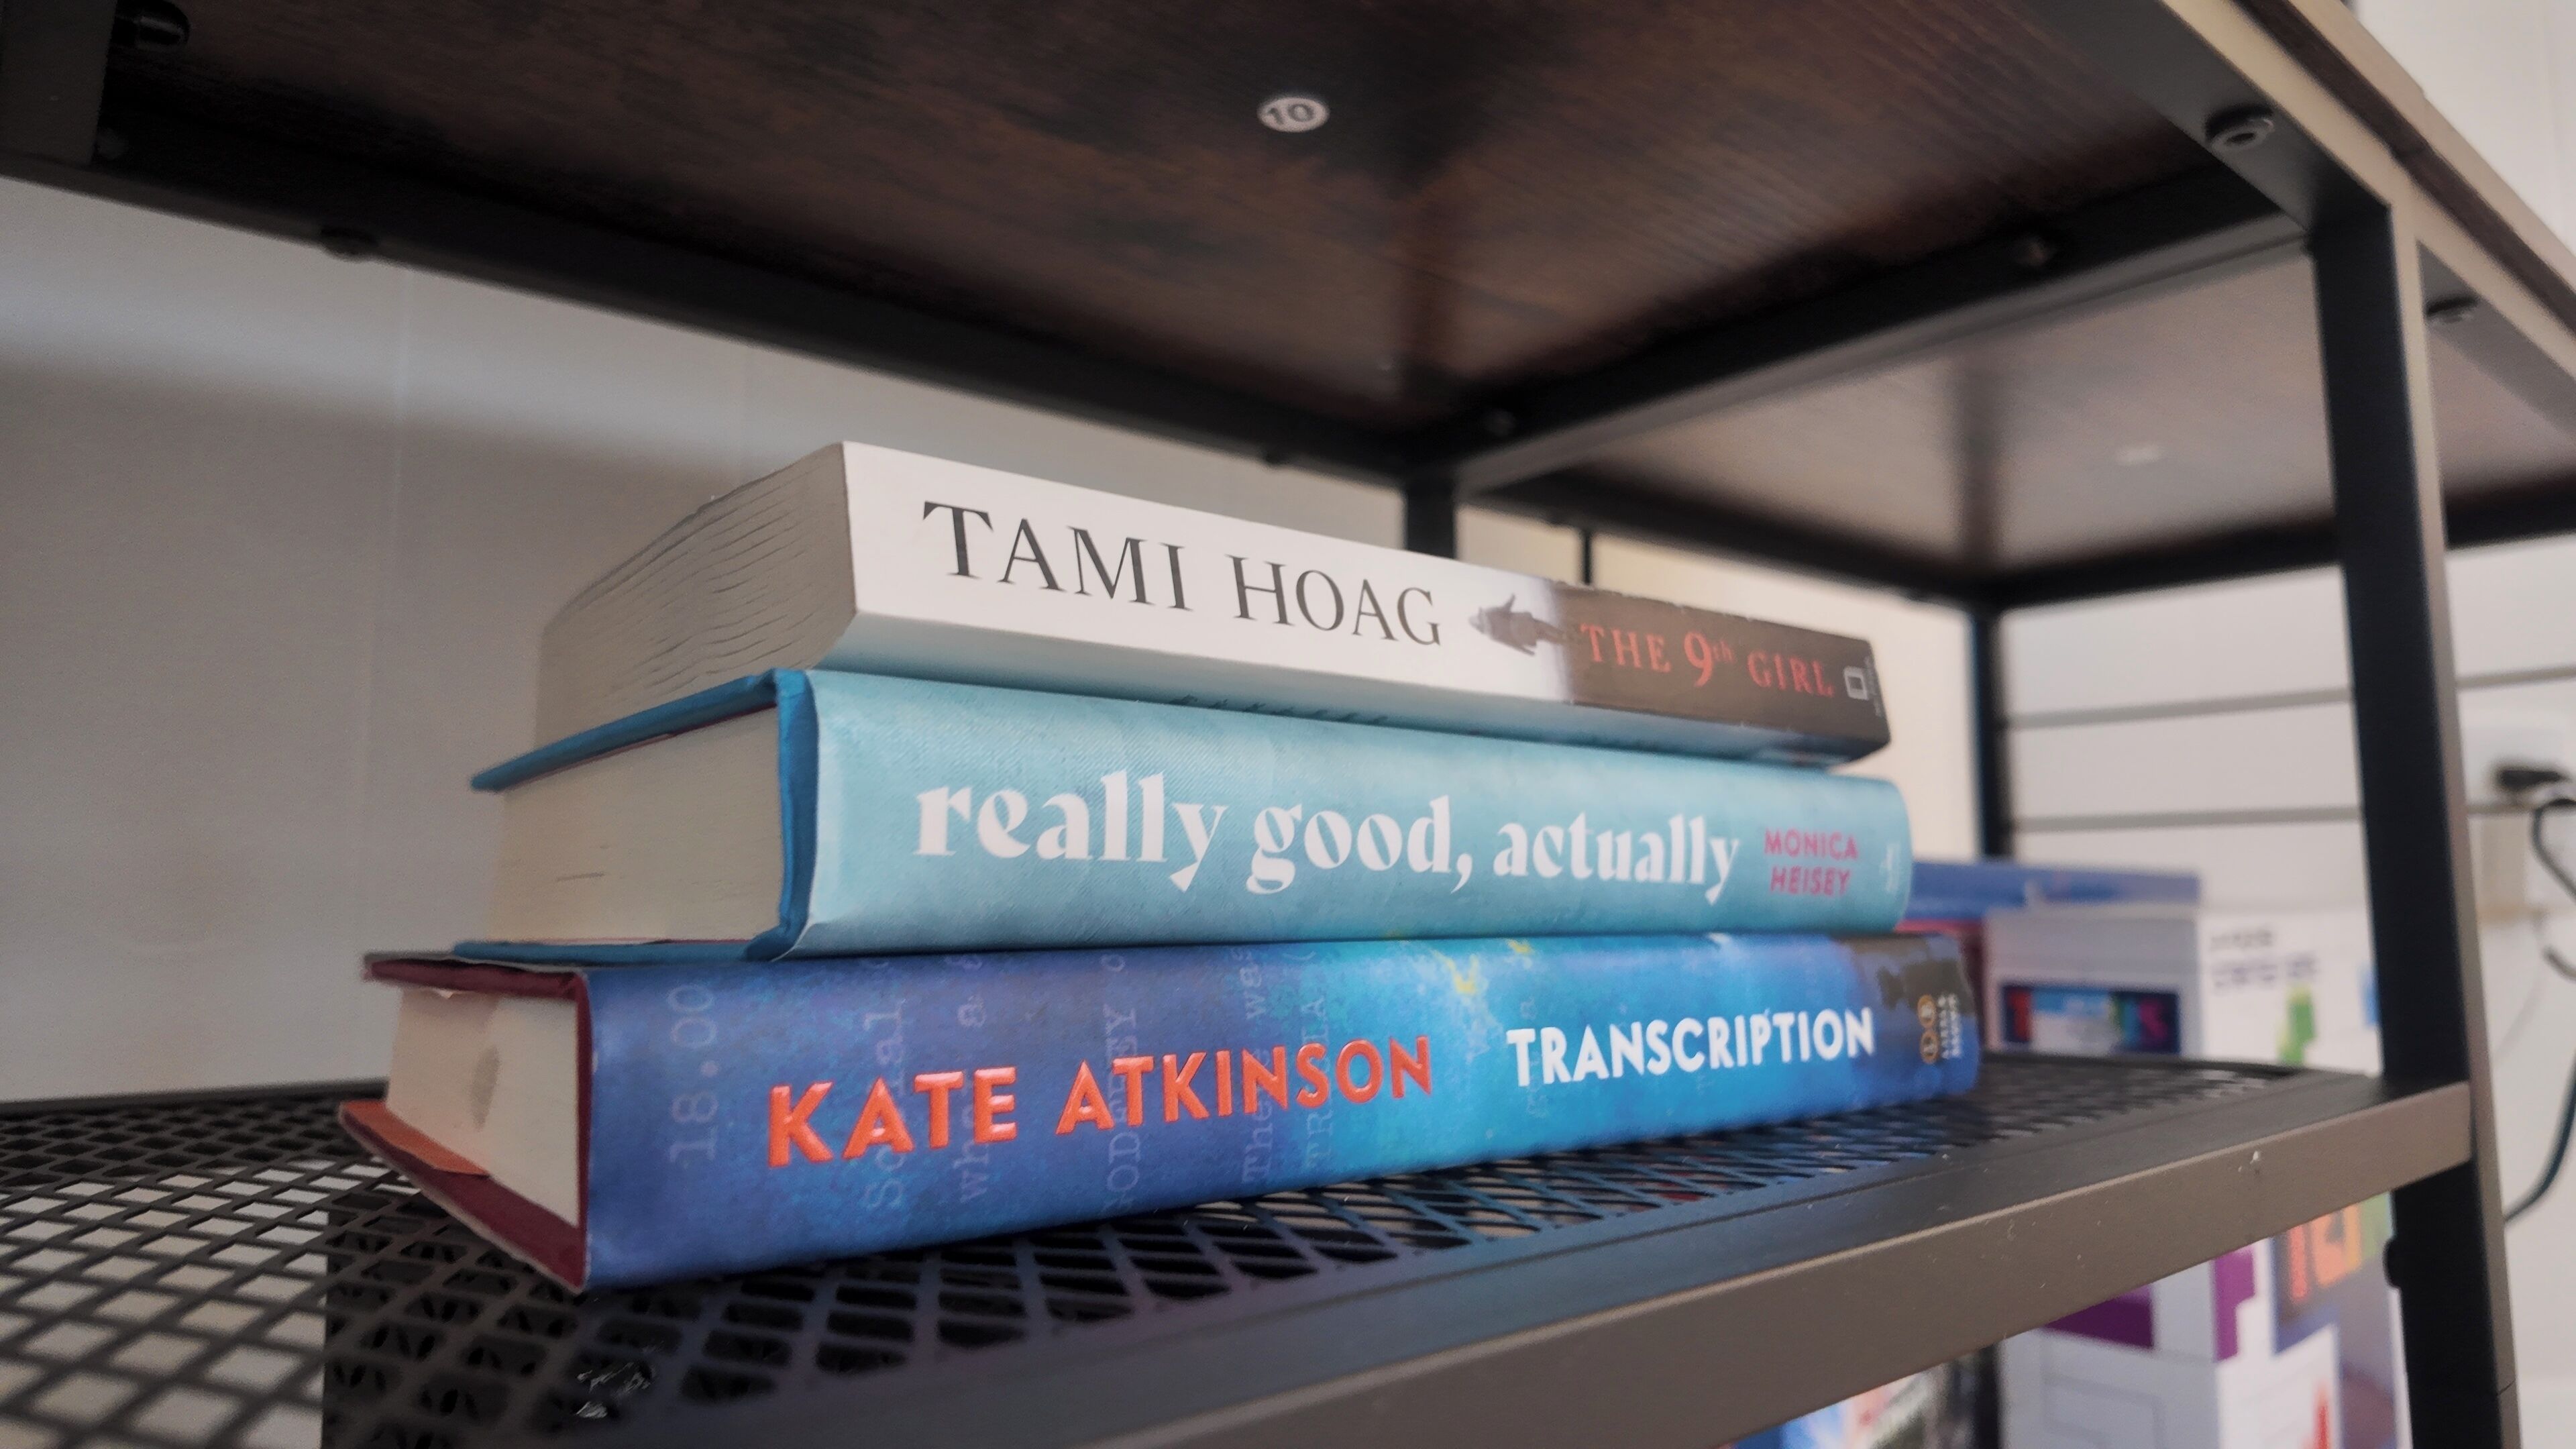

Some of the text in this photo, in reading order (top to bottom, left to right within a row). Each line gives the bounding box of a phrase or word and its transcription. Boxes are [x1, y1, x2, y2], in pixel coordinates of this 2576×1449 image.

[1267, 103, 1315, 125] 10
[923, 500, 1442, 647] TAMI HOAG
[1580, 624, 1672, 673] THE
[1747, 649, 1835, 699] GIRL
[914, 770, 1740, 906] really good, actually
[1763, 828, 1859, 860] MONICA
[1769, 866, 1851, 897] HEISEY
[667, 983, 720, 1165] 18.00
[1505, 1007, 1875, 1087] TRANSCRIPTION
[768, 1066, 1018, 1169] KATE
[1055, 1035, 1432, 1136] ATKINSON
